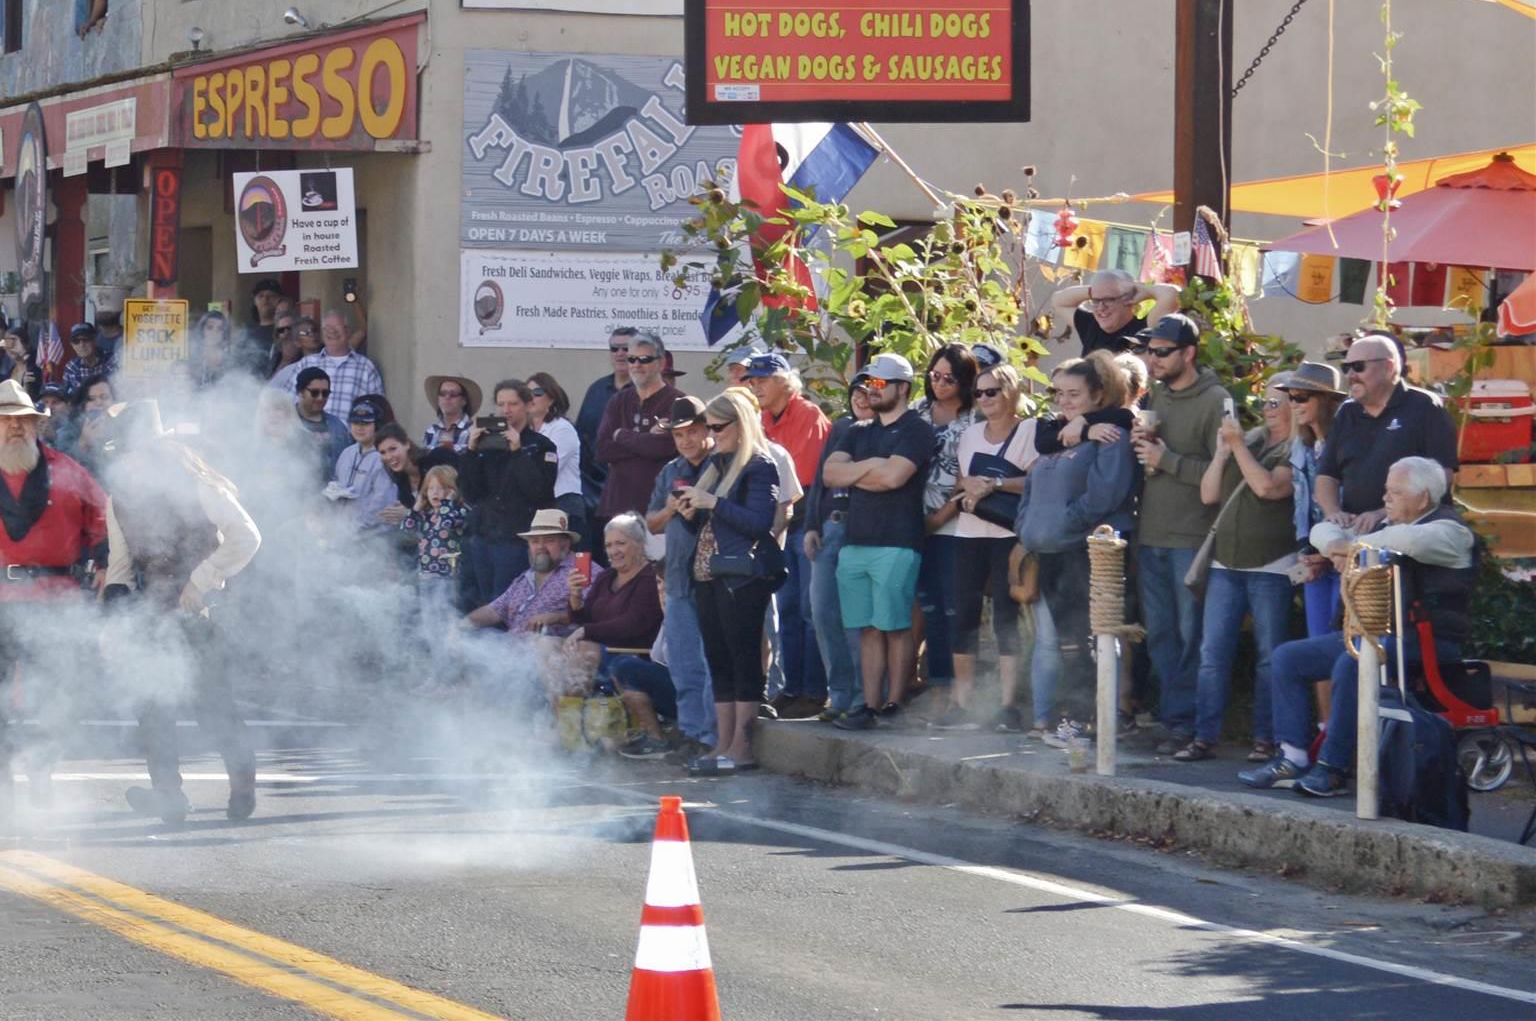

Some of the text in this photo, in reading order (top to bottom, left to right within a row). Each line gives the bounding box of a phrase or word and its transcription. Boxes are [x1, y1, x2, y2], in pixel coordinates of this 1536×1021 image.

[724, 12, 991, 39] HOT DOGS, CHILI DOGS
[714, 55, 1003, 81] VEGAN DOGS & SAUSAGES
[193, 37, 406, 140] ESPRESSO
[154, 170, 177, 280] OPEN
[292, 218, 314, 229] Have
[324, 219, 338, 229] cup
[340, 216, 349, 227] of
[471, 211, 679, 227] Fresh Roasted Beans Espresso Cappuccino
[303, 232, 340, 241] in house
[469, 228, 507, 241] OPEN
[509, 229, 517, 241] 7
[520, 229, 553, 242] DAYS
[557, 230, 566, 242] A
[568, 231, 607, 243] WEEK
[304, 243, 340, 253] Roasted
[294, 255, 351, 265] Fresh Coffee
[482, 266, 506, 278] Fresh
[509, 266, 527, 278] Deli
[589, 269, 621, 282] Veggie
[592, 286, 611, 298] Any
[613, 288, 627, 297] one
[642, 287, 659, 299] only
[131, 314, 181, 324] YOSEMITE
[516, 305, 540, 317] Fresh
[543, 307, 567, 318] Made
[611, 308, 658, 320] Smoothies
[662, 310, 668, 320] &
[137, 329, 175, 343] SACK
[132, 347, 180, 359] LUNCH
